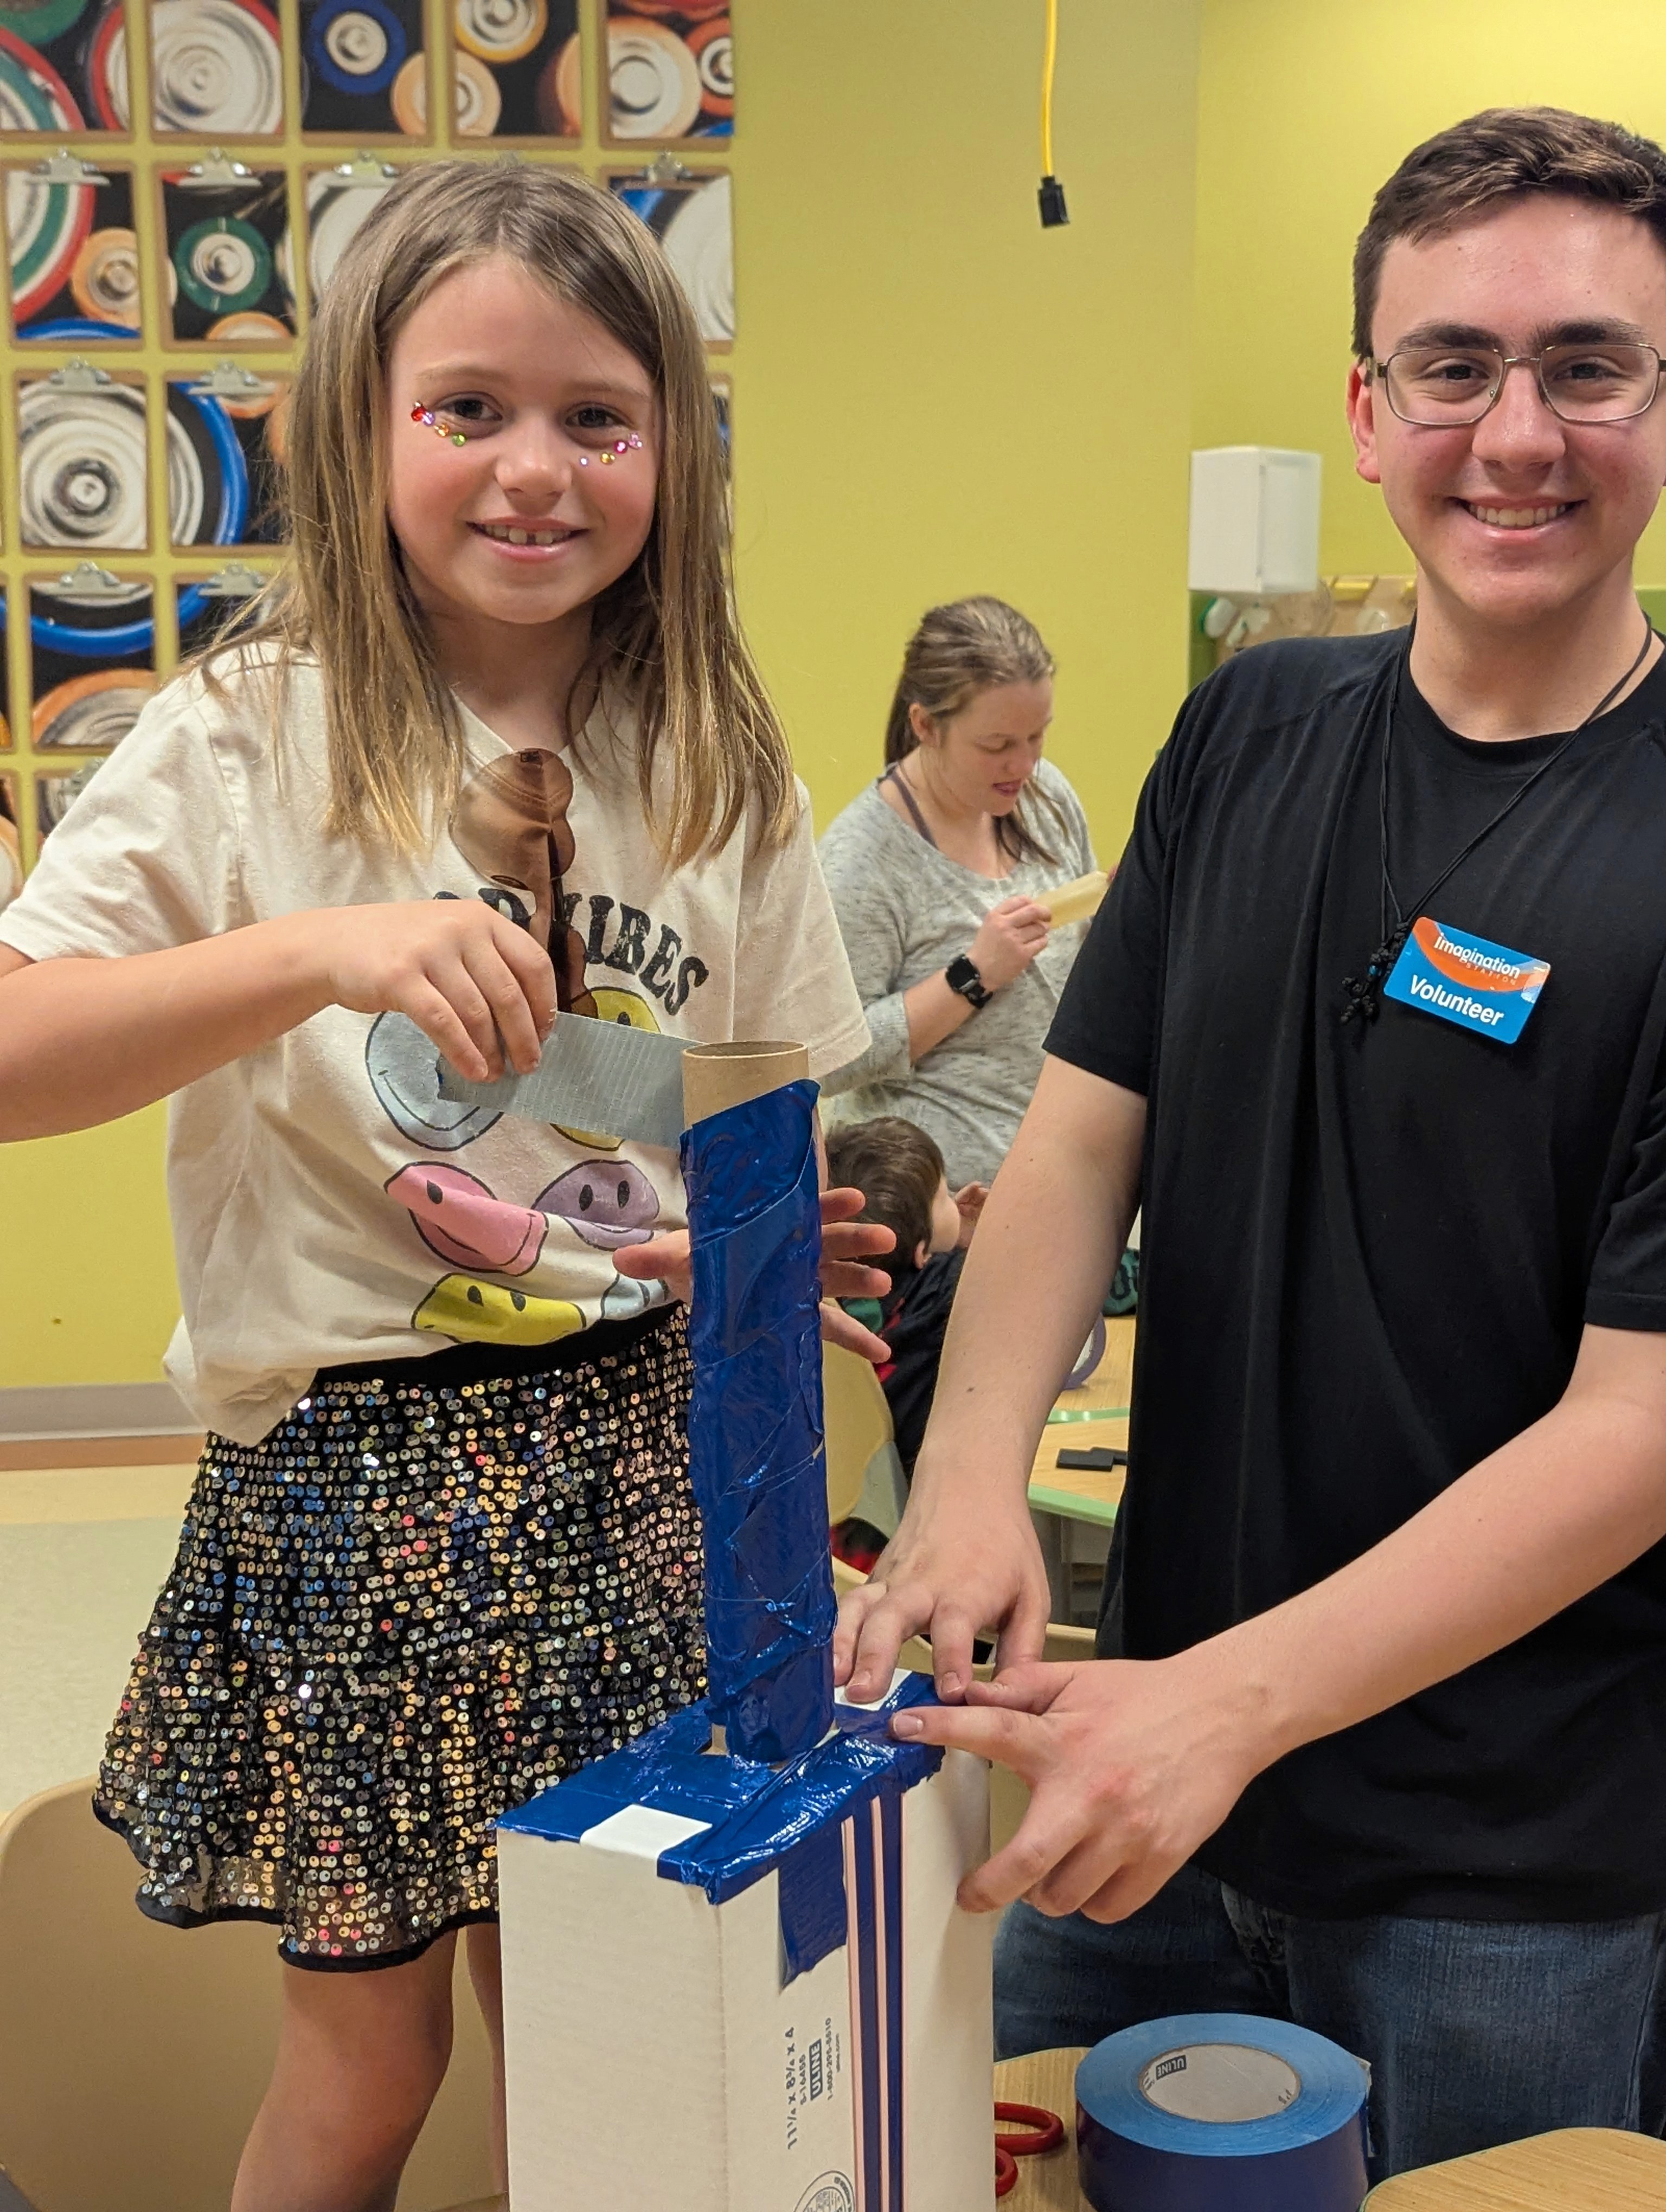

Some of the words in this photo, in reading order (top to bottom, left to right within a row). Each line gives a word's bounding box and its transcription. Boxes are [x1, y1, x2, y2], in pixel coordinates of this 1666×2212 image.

[1465, 962, 1516, 986] STATION
[1411, 974, 1504, 1026] Volunteer
[785, 2027, 794, 2037] 4
[810, 2042, 821, 2095] ULINE
[1157, 2057, 1184, 2078] ULINE
